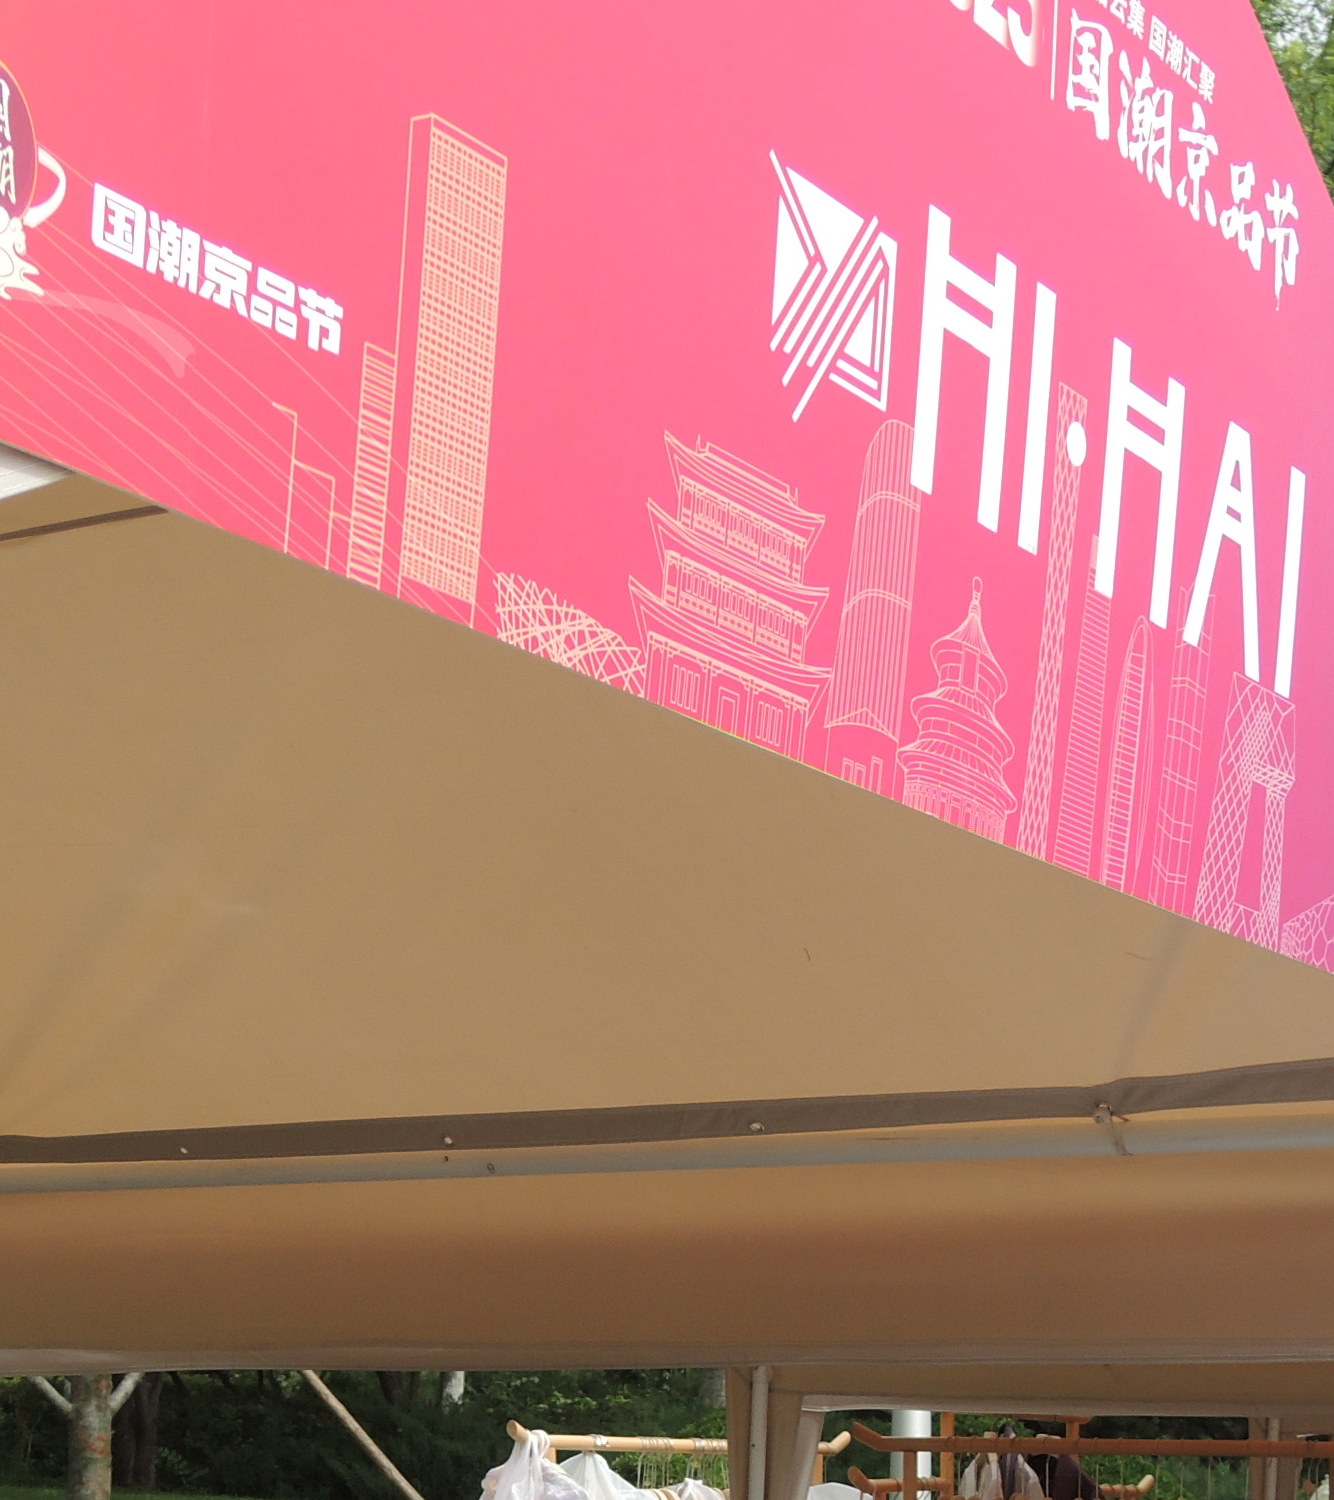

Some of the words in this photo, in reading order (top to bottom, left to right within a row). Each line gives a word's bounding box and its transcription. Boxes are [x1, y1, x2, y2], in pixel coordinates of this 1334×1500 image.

[1148, 15, 1216, 104] 国潮汇聚
[1066, 8, 1299, 311] 国潮京品节
[91, 183, 344, 356] 国潮京品节
